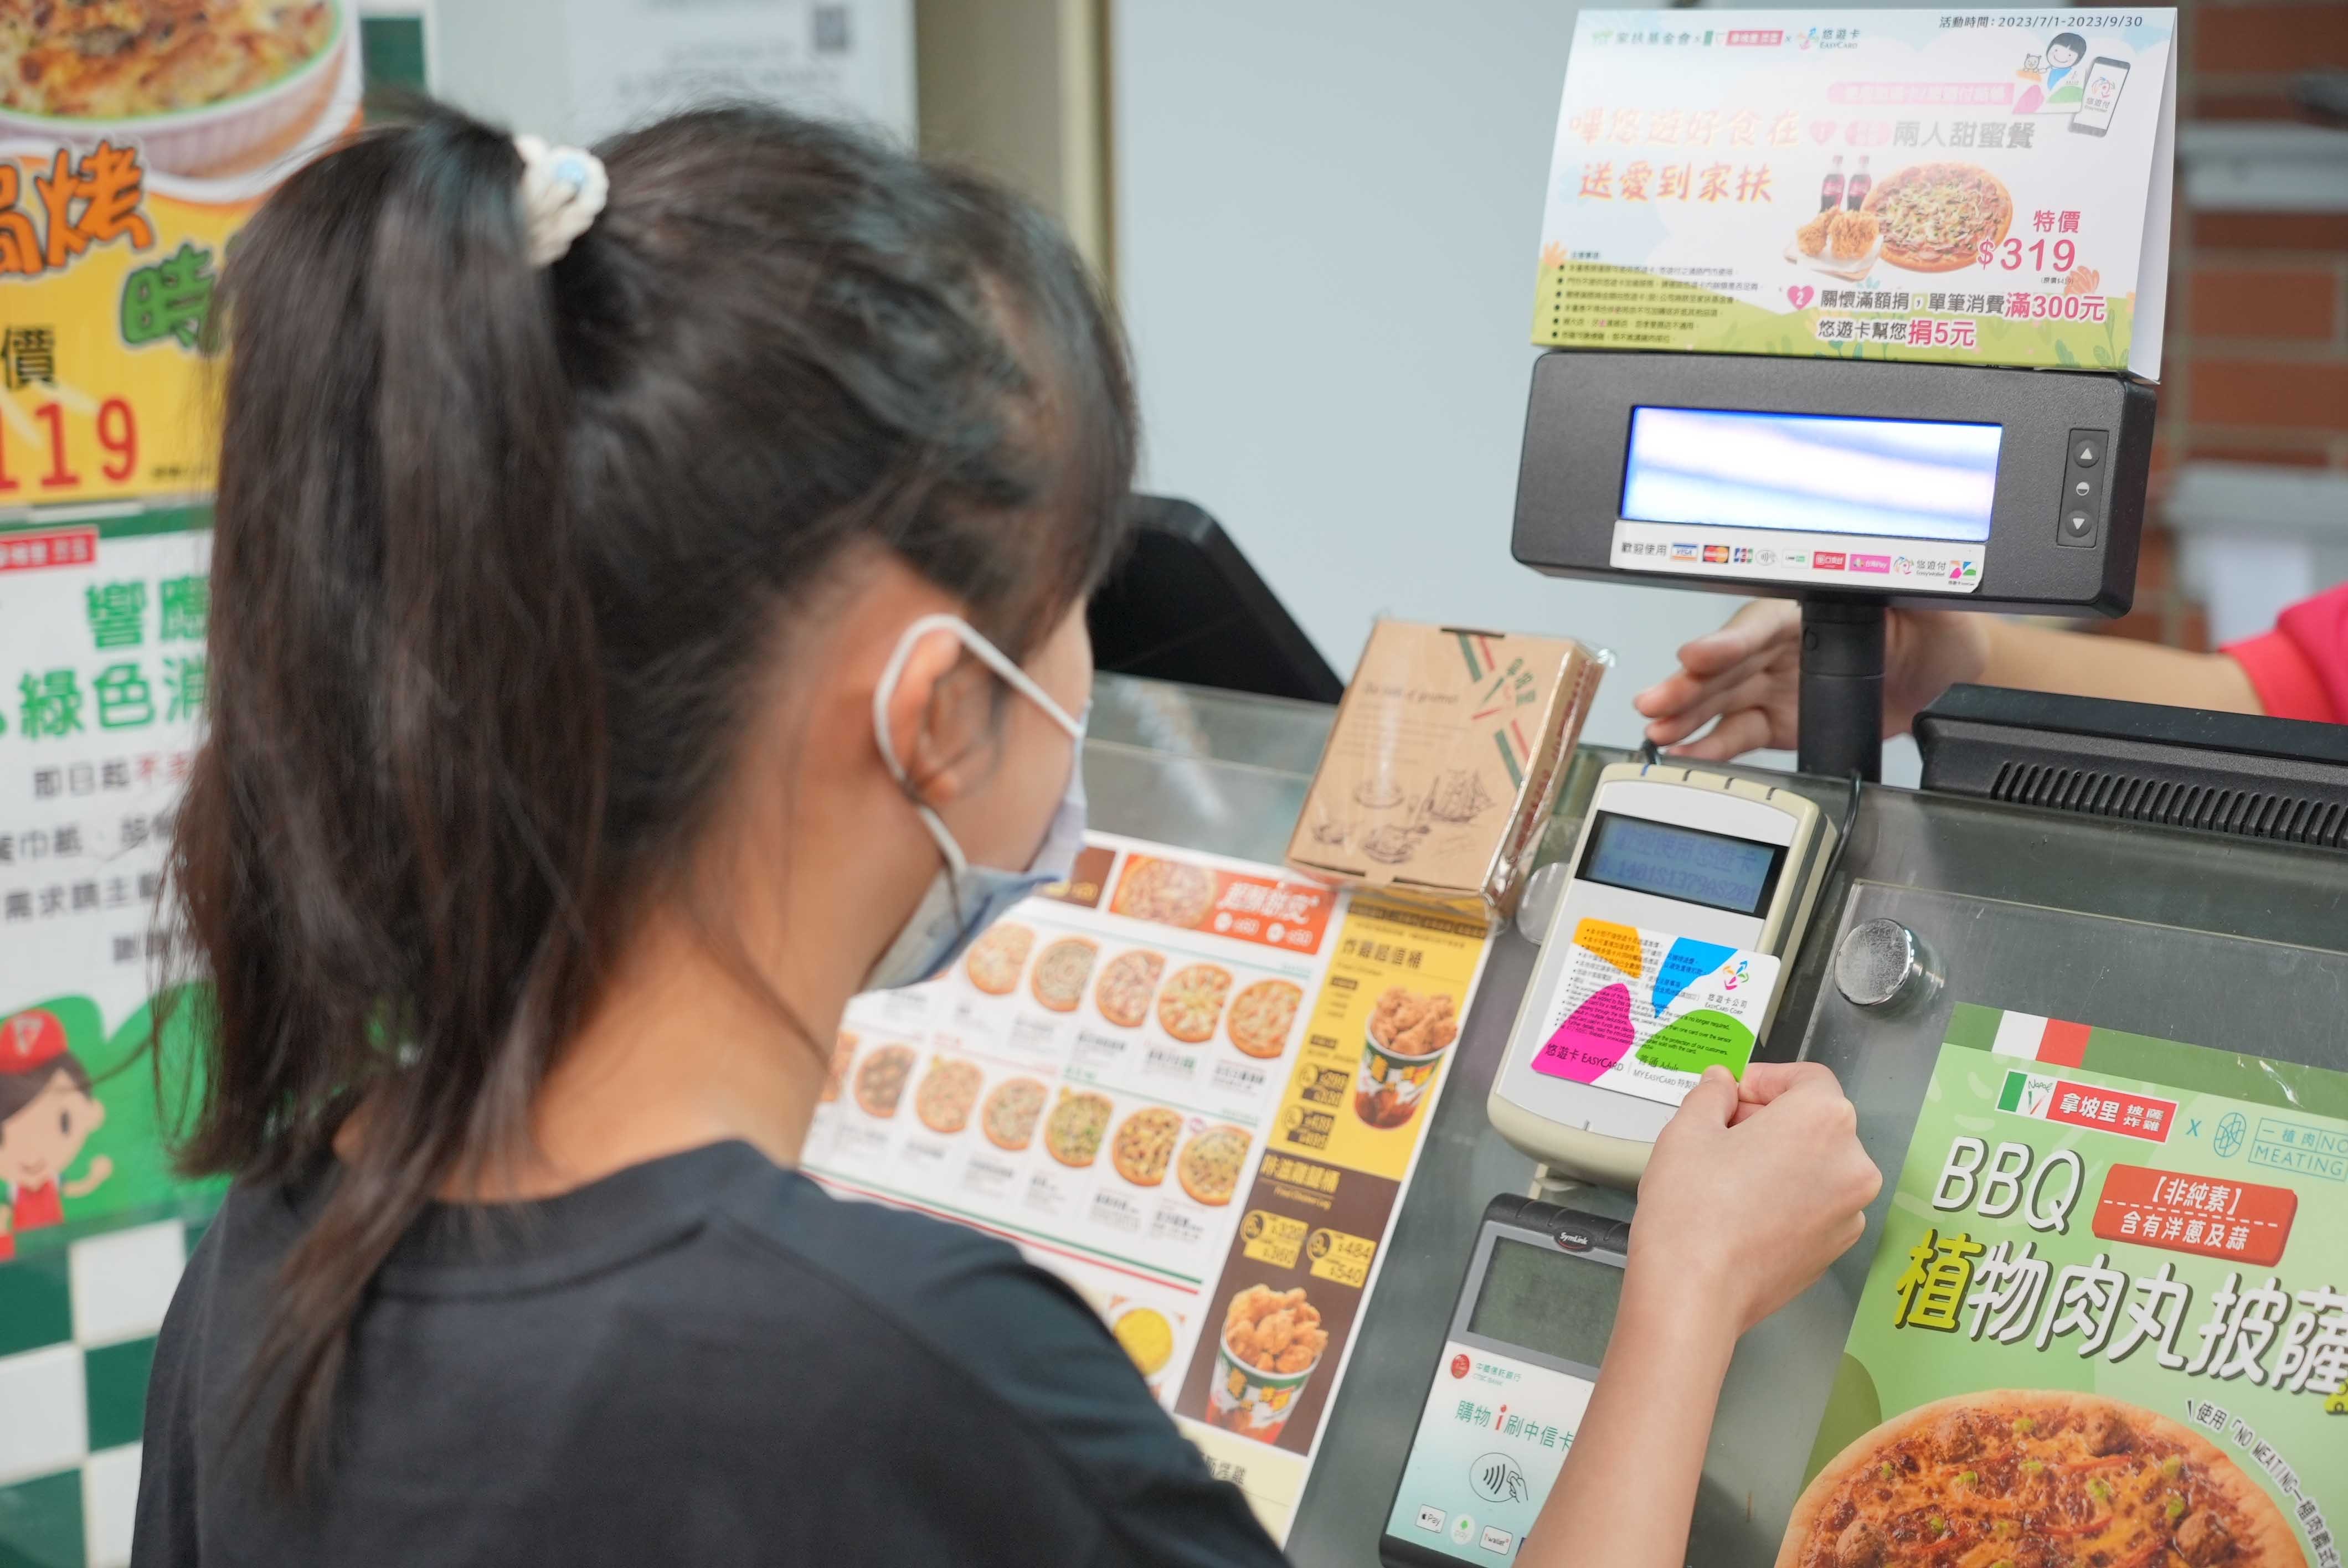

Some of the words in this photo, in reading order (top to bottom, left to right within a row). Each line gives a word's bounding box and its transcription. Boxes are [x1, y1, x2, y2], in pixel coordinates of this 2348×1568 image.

[1822, 28, 1861, 40] 悠遊卡
[1893, 121, 2035, 149] 兩人甜蜜餐
[1579, 160, 1774, 203] 送愛到家扶
[2033, 209, 2082, 235] 特價
[1977, 238, 2076, 272] $319
[1818, 319, 1976, 348] 悠遊卡幫您捐5元
[1621, 541, 1667, 557] 歡迎使用
[1916, 560, 1947, 571] 悠遊付
[1707, 993, 1748, 1009] 悠遊卡公司
[1546, 1043, 1579, 1062] 悠遊卡
[1659, 1061, 1679, 1072] Adult
[2058, 1092, 2121, 1125] 拿坡里
[2126, 1103, 2165, 1120] 披薩
[2122, 1116, 2161, 1133] 炸雞
[2262, 1126, 2316, 1148] 一植肉
[2253, 1146, 2343, 1175] MEATING
[1931, 1136, 2086, 1236] BBQ
[2151, 1175, 2243, 1216] 【非純素】
[1559, 1231, 1589, 1246] SymLink
[2120, 1211, 2250, 1251] 含有洋蔥及蒜
[1893, 1229, 2348, 1399] 植物肉丸披薩
[1476, 1362, 1522, 1383] 中國信託銀行
[1427, 1512, 1441, 1528] Pay
